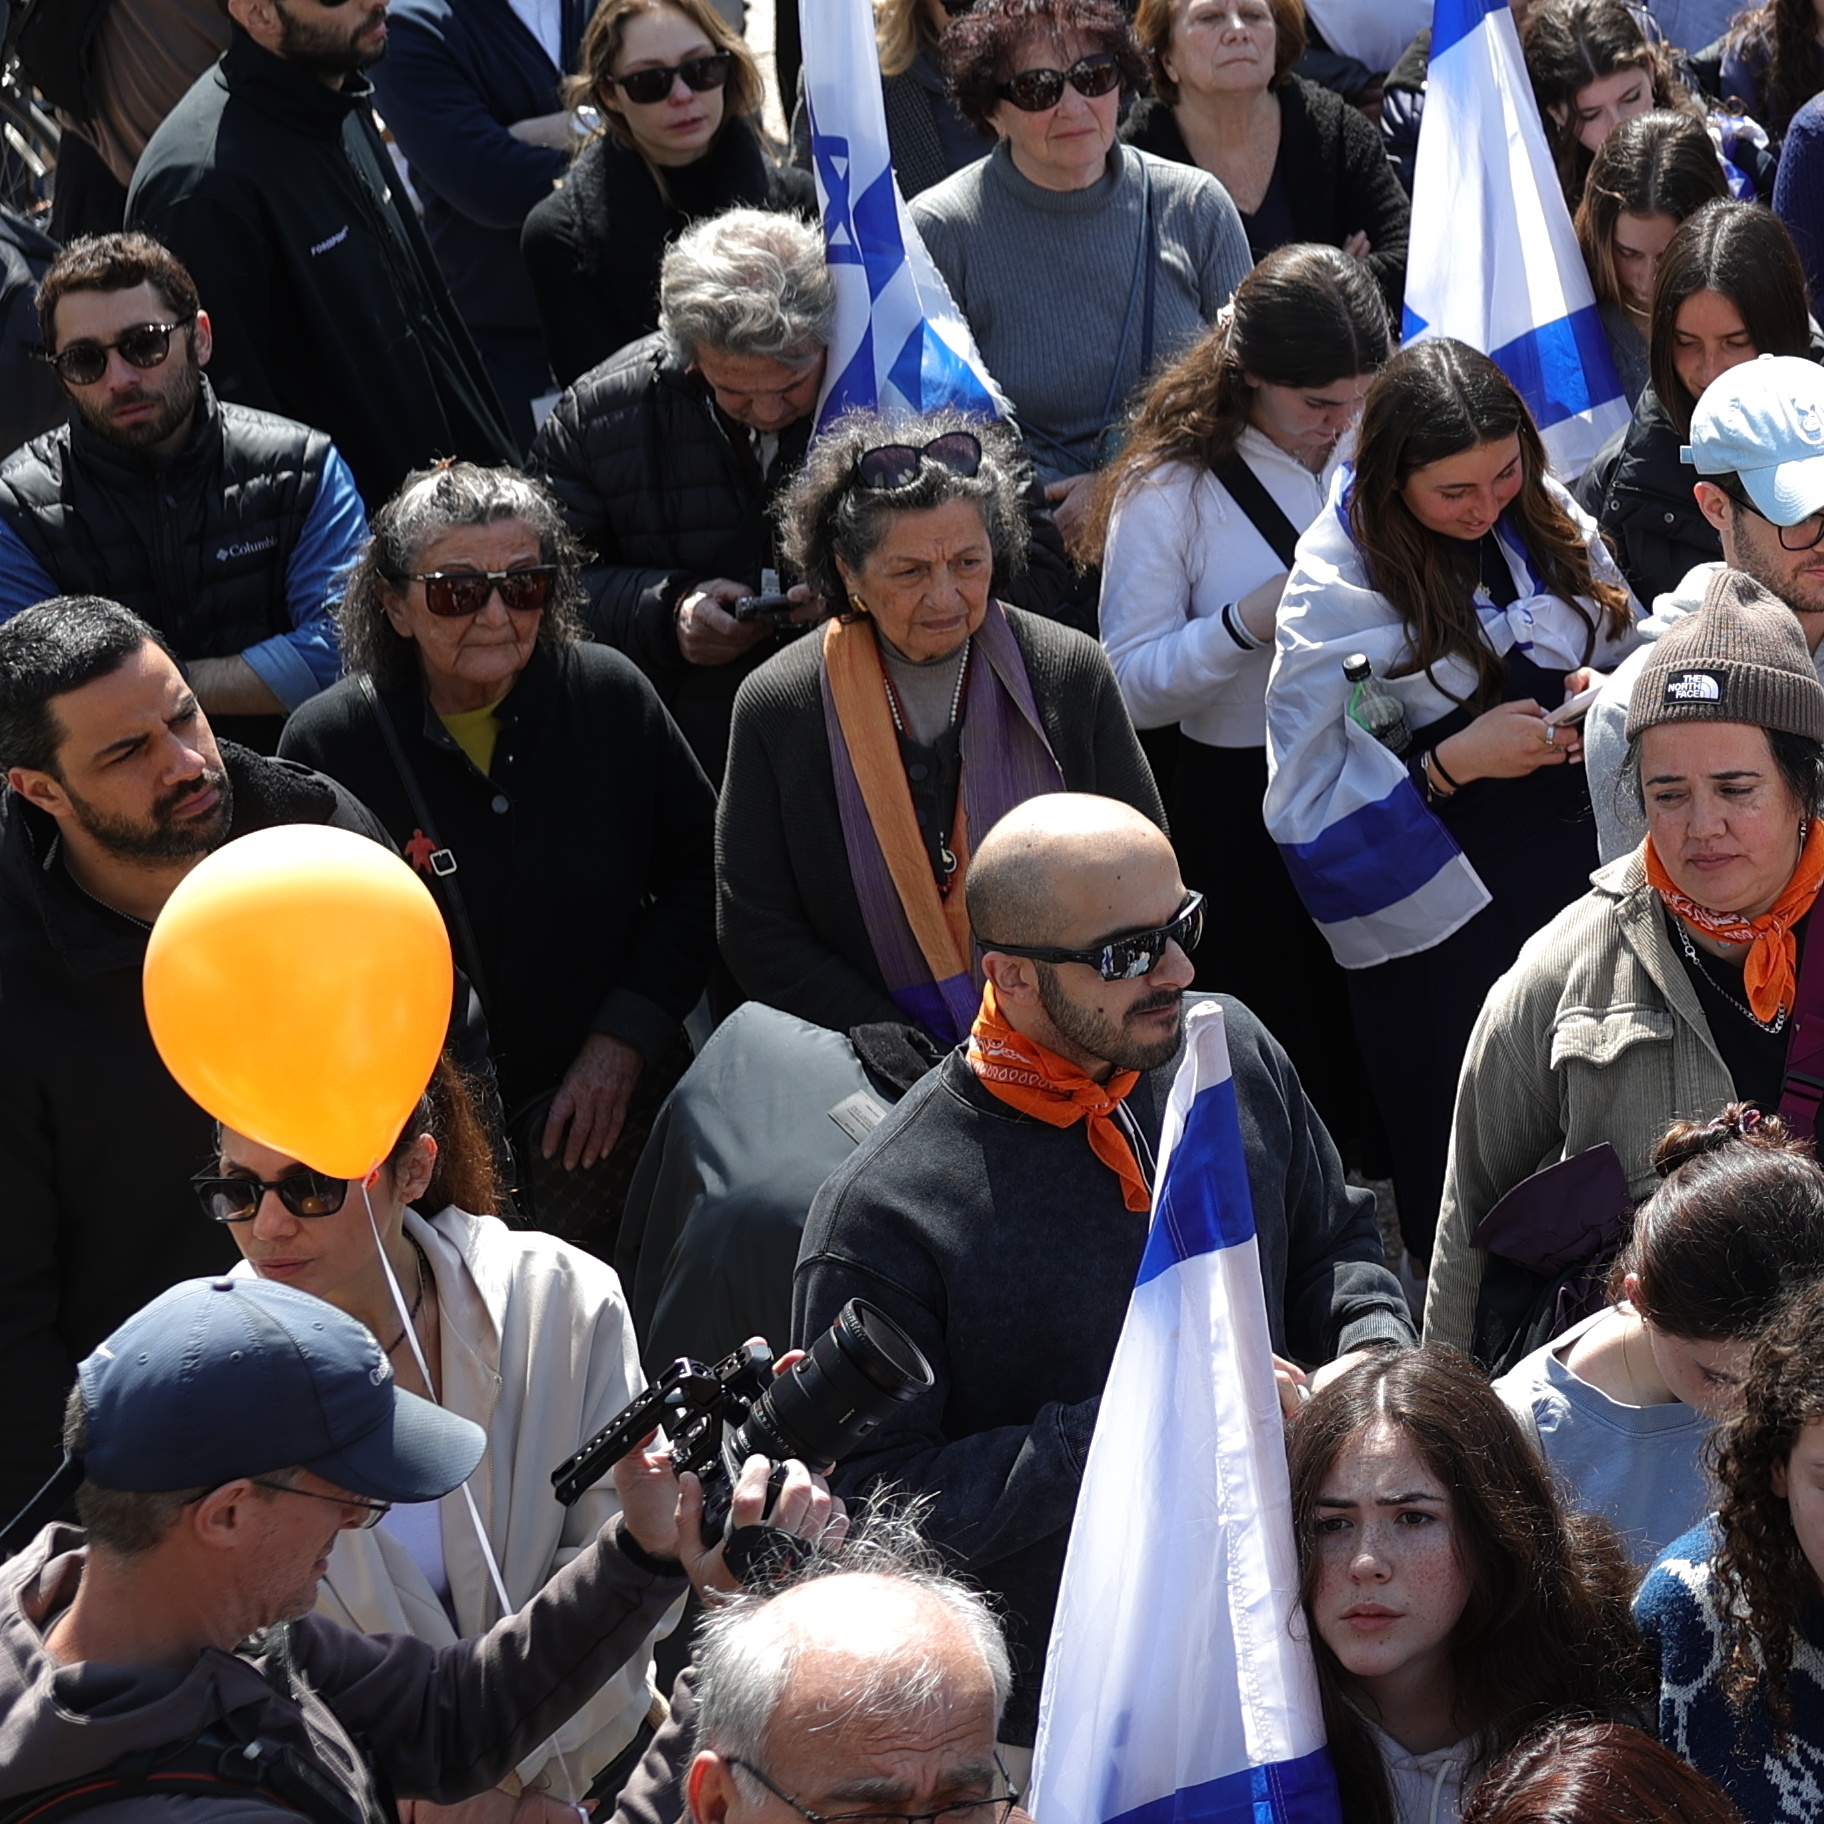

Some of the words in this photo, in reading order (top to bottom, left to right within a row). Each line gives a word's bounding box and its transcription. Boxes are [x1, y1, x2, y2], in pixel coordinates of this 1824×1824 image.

[1682, 674, 1701, 683] THE
[1667, 682, 1701, 693] NORTH
[1675, 690, 1700, 699] FACE
